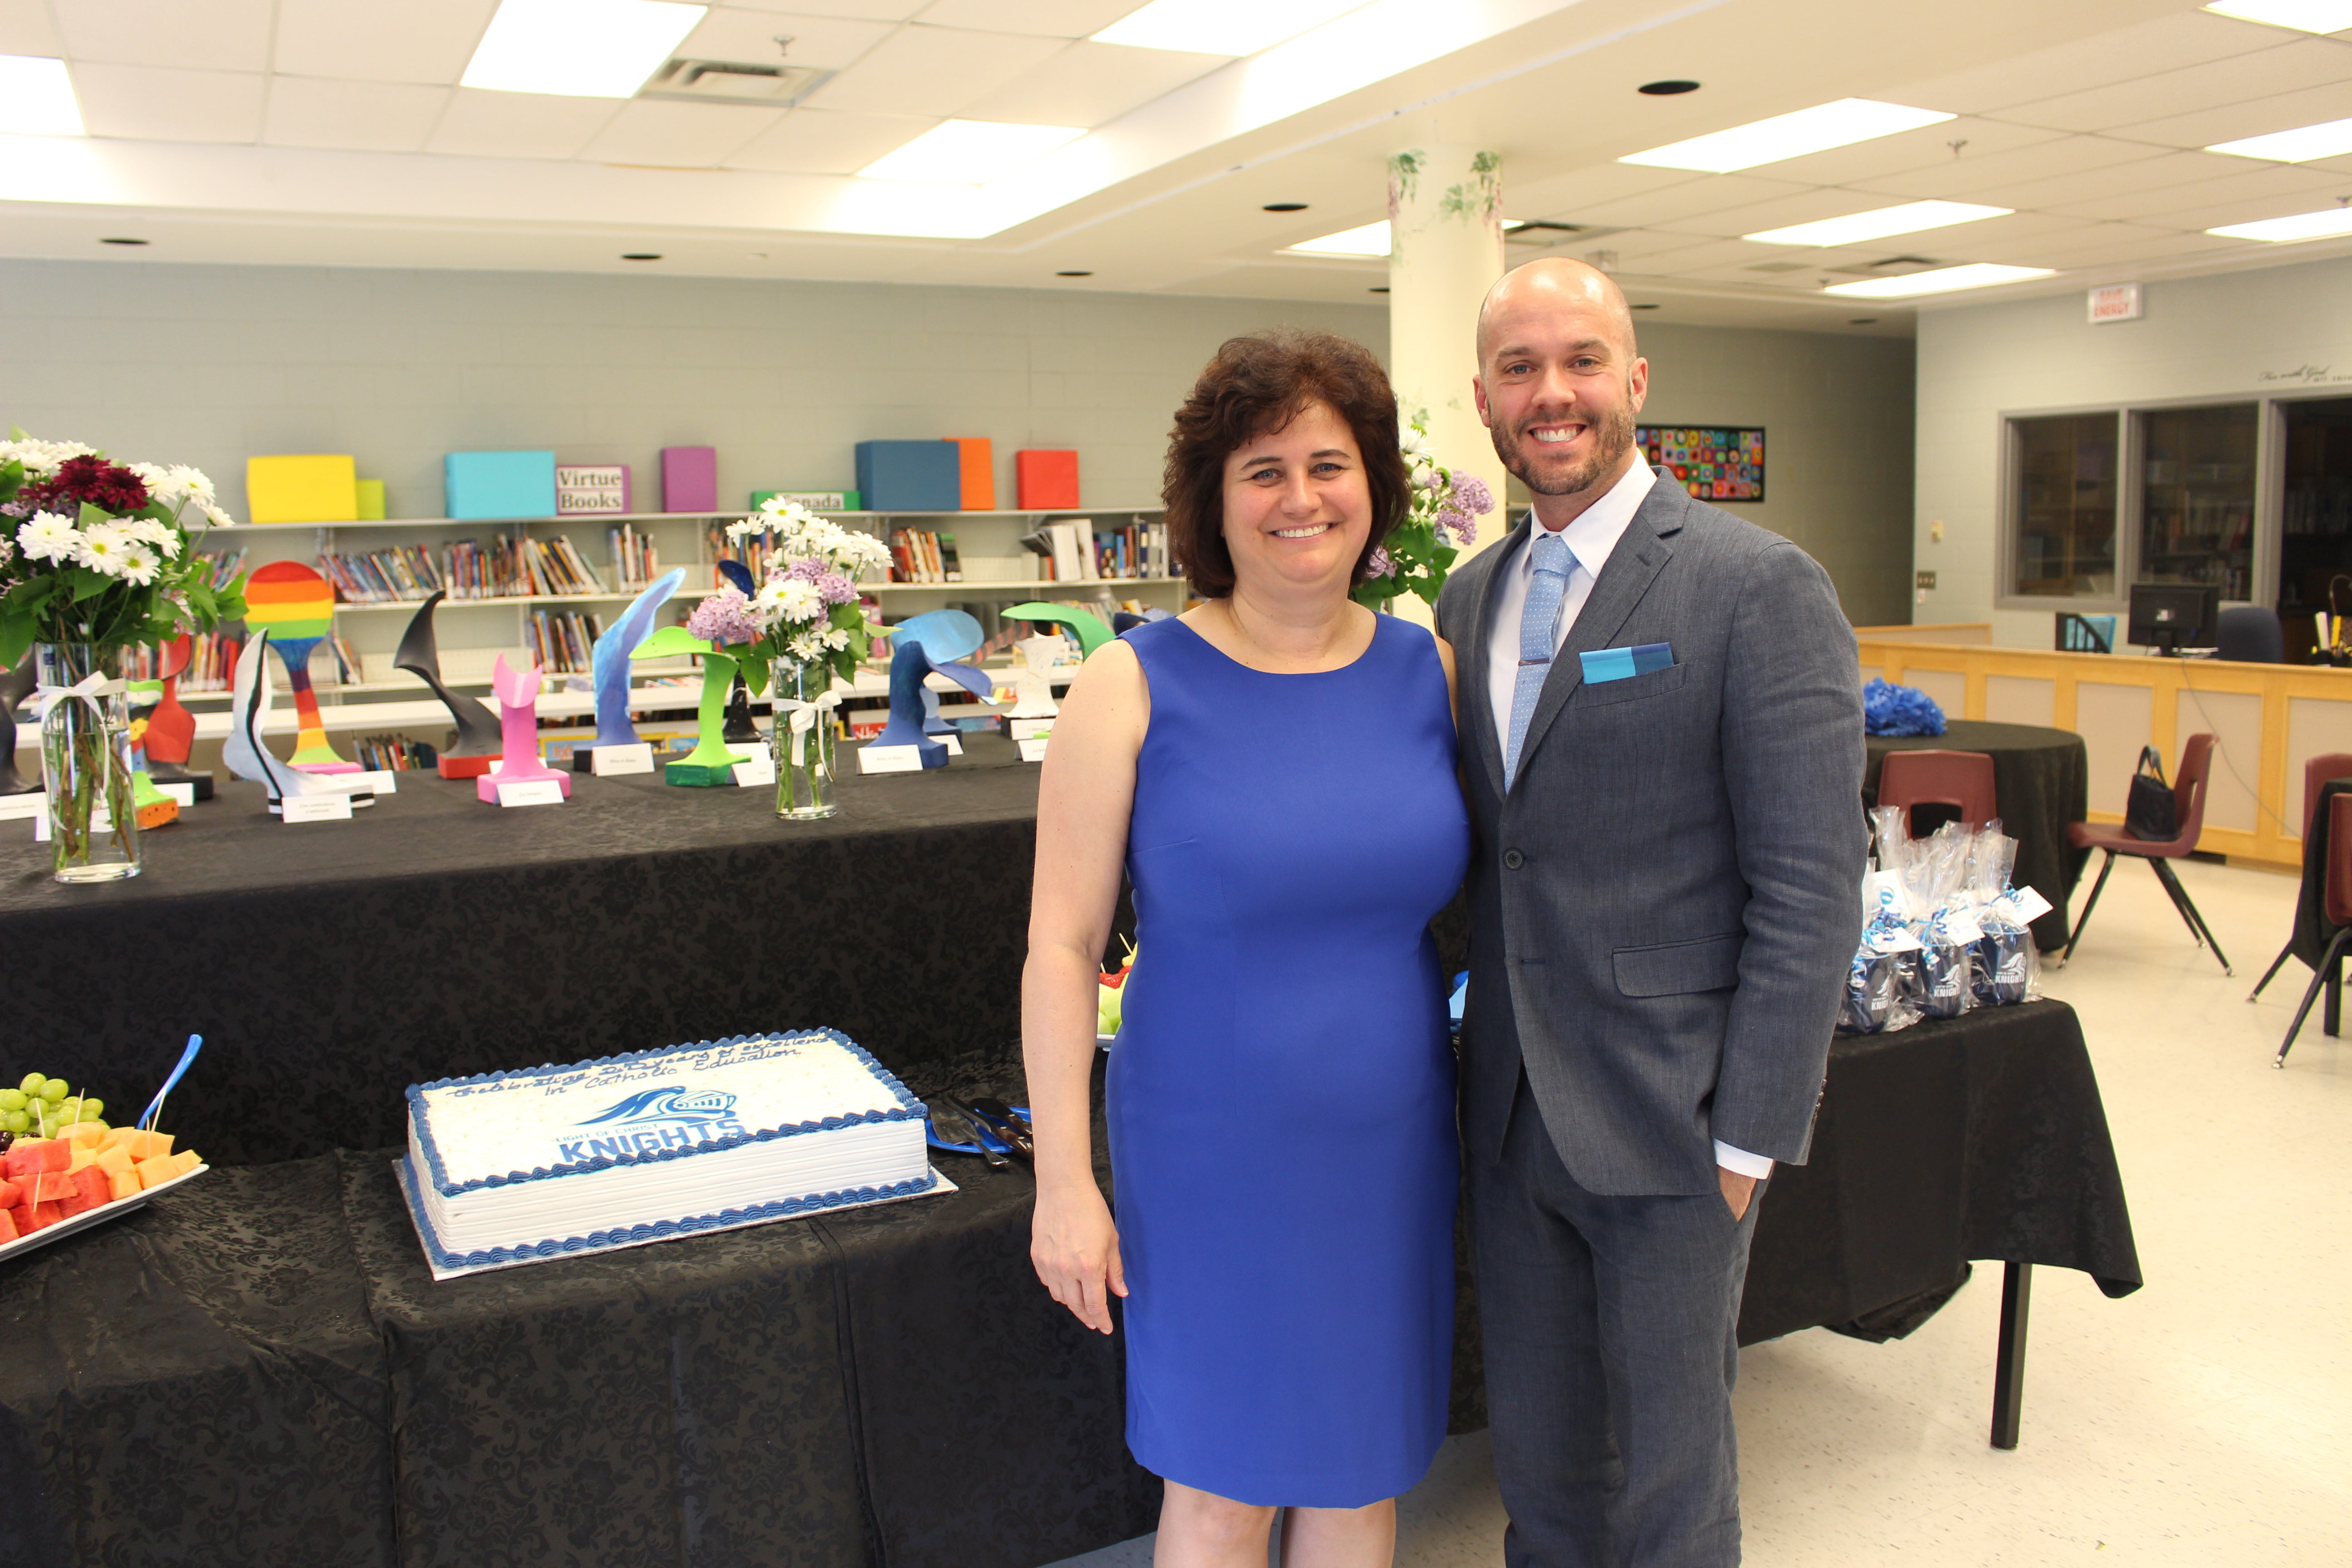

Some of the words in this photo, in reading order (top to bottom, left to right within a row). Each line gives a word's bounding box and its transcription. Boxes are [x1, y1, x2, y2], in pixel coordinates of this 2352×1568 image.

[559, 470, 621, 486] Virtue
[561, 492, 621, 509] Books
[1995, 974, 2025, 984] KNIGHTS
[1934, 987, 1960, 997] KNIGHT
[693, 1049, 801, 1071] Education
[555, 1133, 590, 1143] LIGHT
[615, 1123, 658, 1135] CHRIST
[559, 1118, 747, 1163] KNIGHTS
